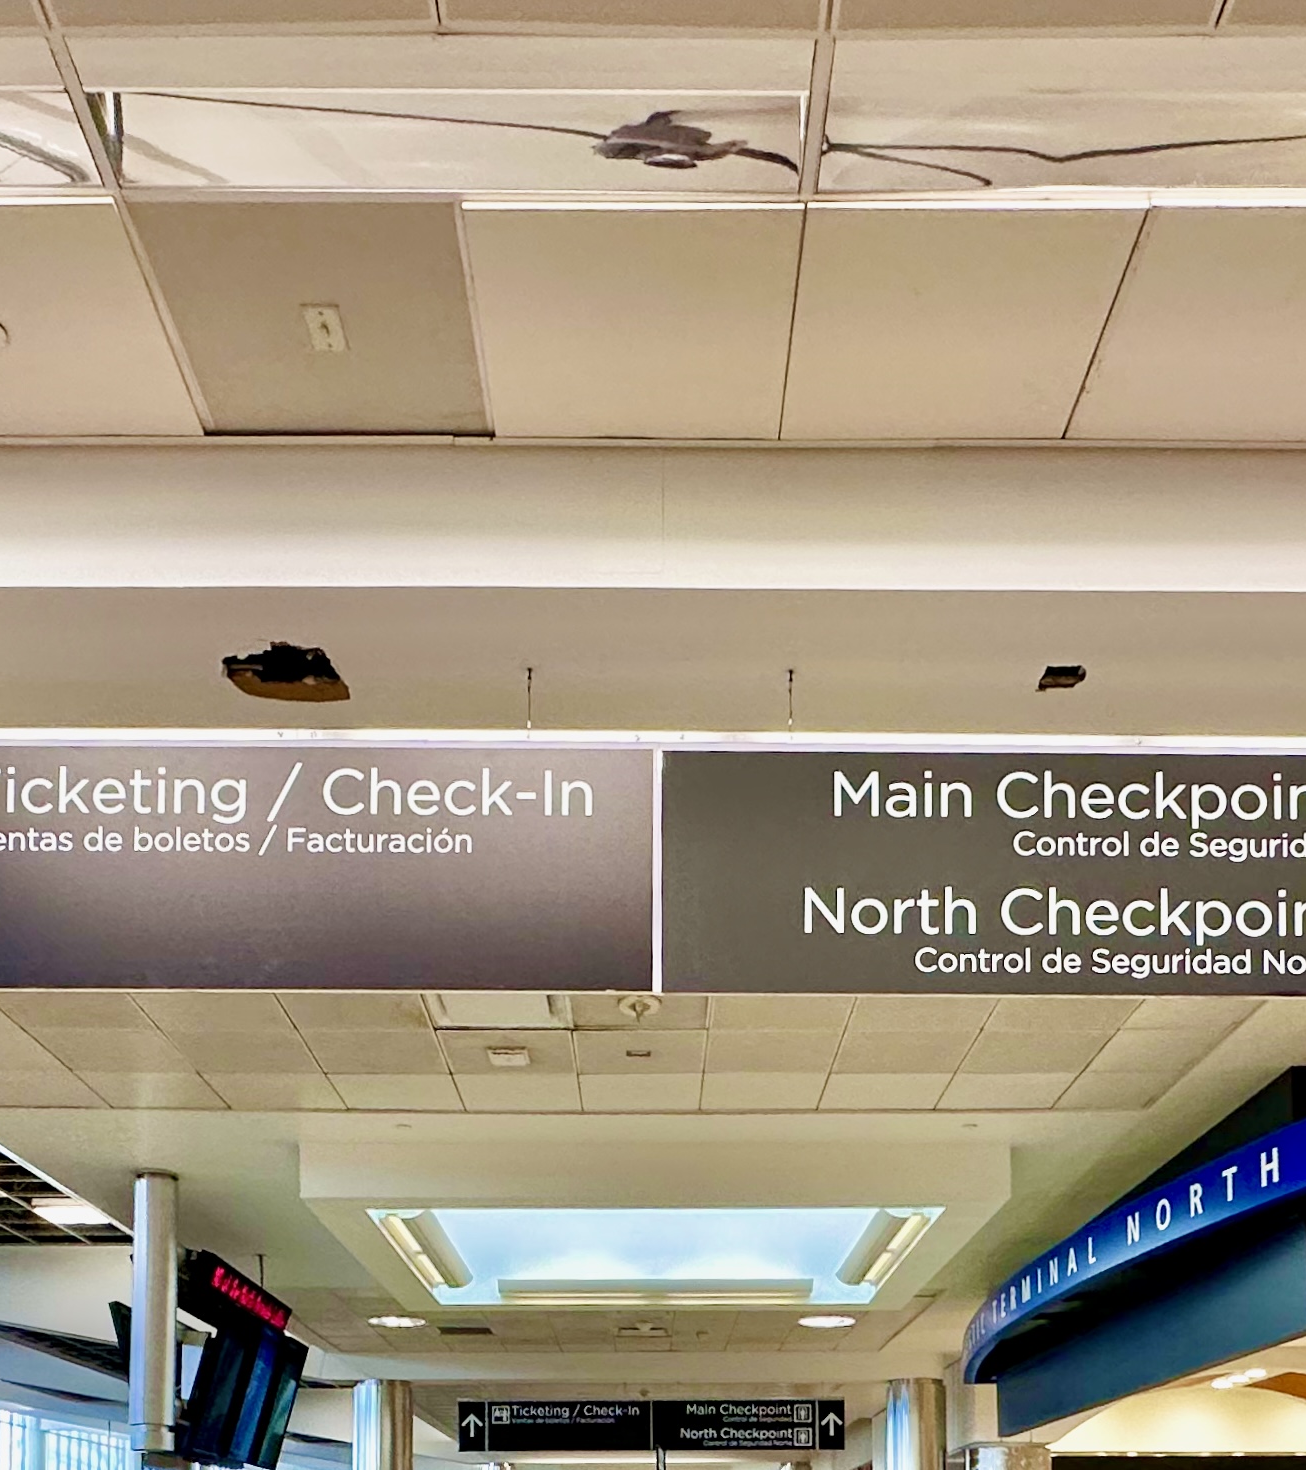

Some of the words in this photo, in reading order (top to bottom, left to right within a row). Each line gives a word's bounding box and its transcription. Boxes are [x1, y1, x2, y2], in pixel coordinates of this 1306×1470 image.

[266, 761, 304, 822] /
[322, 766, 594, 817] Check-In
[832, 769, 974, 819] Main
[83, 826, 123, 852] de
[133, 825, 251, 853] boletos
[257, 824, 278, 857] /
[286, 826, 473, 855] Facturación
[1012, 830, 1130, 857] Control
[1140, 830, 1180, 858] de
[803, 885, 978, 937] North
[914, 946, 1031, 974] Control
[1041, 946, 1082, 975] de
[1091, 947, 1252, 980] Seguridad
[992, 1235, 1097, 1326] TERMINAL
[1125, 1146, 1280, 1246] NORTH
[511, 1405, 571, 1419] Ticketing
[583, 1404, 641, 1416] Check-In
[686, 1403, 717, 1416] Main
[719, 1403, 793, 1417] Checkpoint
[679, 1427, 718, 1440] North
[720, 1427, 793, 1441] Checkpoint
